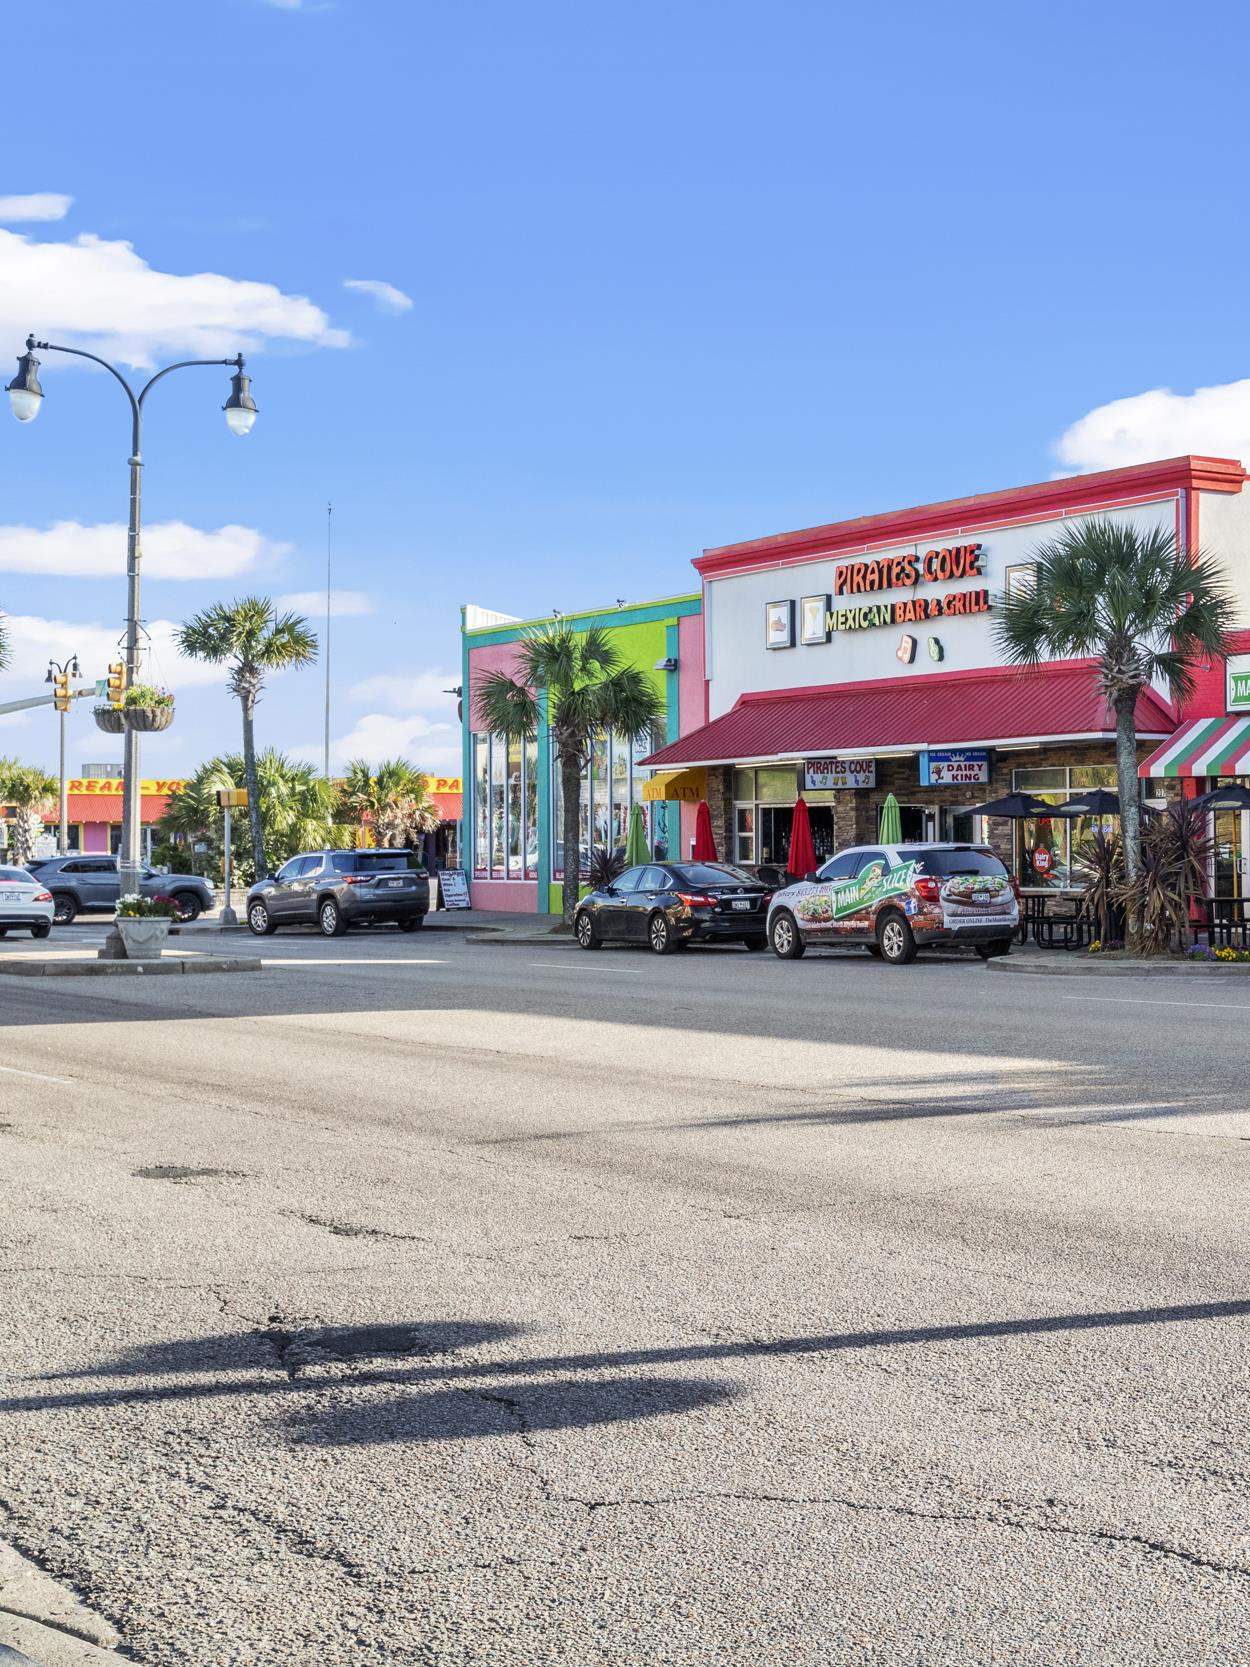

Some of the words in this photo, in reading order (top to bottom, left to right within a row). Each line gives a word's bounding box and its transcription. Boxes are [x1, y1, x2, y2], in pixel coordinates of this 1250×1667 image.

[834, 553, 920, 596] PIRATES
[923, 543, 982, 582] COVE
[825, 603, 894, 632] MEXICAN
[895, 597, 931, 624] BAR
[930, 597, 944, 617] &
[943, 589, 990, 616] GRILL
[806, 761, 847, 775] PIRATES
[849, 760, 873, 774] COVE
[946, 763, 984, 772] DAIRY
[951, 773, 980, 782] KING
[68, 780, 125, 792] REA
[646, 787, 662, 799] ATM
[671, 787, 700, 799] ATM
[837, 885, 859, 907] MAIN
[883, 870, 907, 891] SLICE
